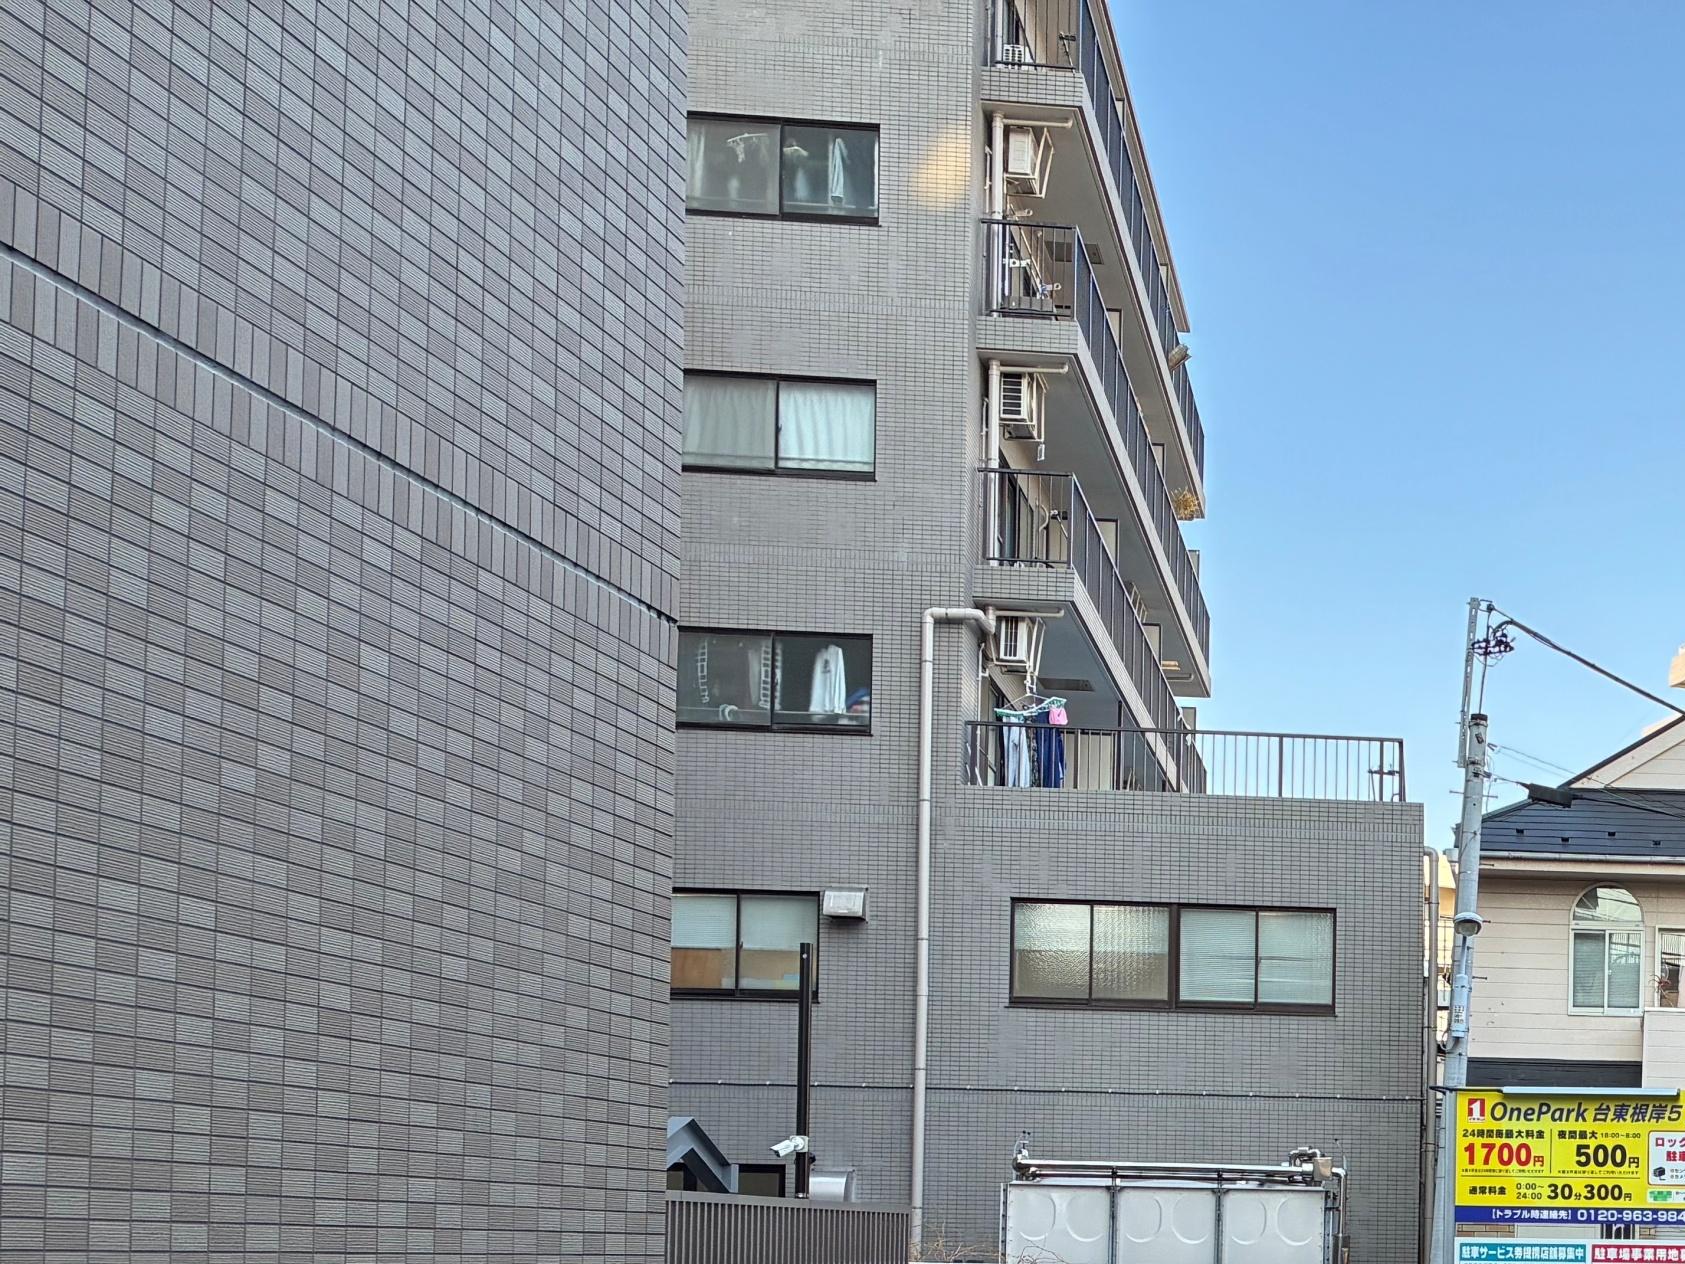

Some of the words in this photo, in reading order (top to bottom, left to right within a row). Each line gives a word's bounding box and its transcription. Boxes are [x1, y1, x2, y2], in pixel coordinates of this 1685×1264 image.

[1490, 1101, 1589, 1122] OnePark
[1557, 1130, 1598, 1140] 夜間最大
[1463, 1142, 1545, 1167] 1700円
[1575, 1143, 1640, 1169] 500円
[1468, 1186, 1507, 1196] 通常料金
[1516, 1192, 1543, 1200] 24:00
